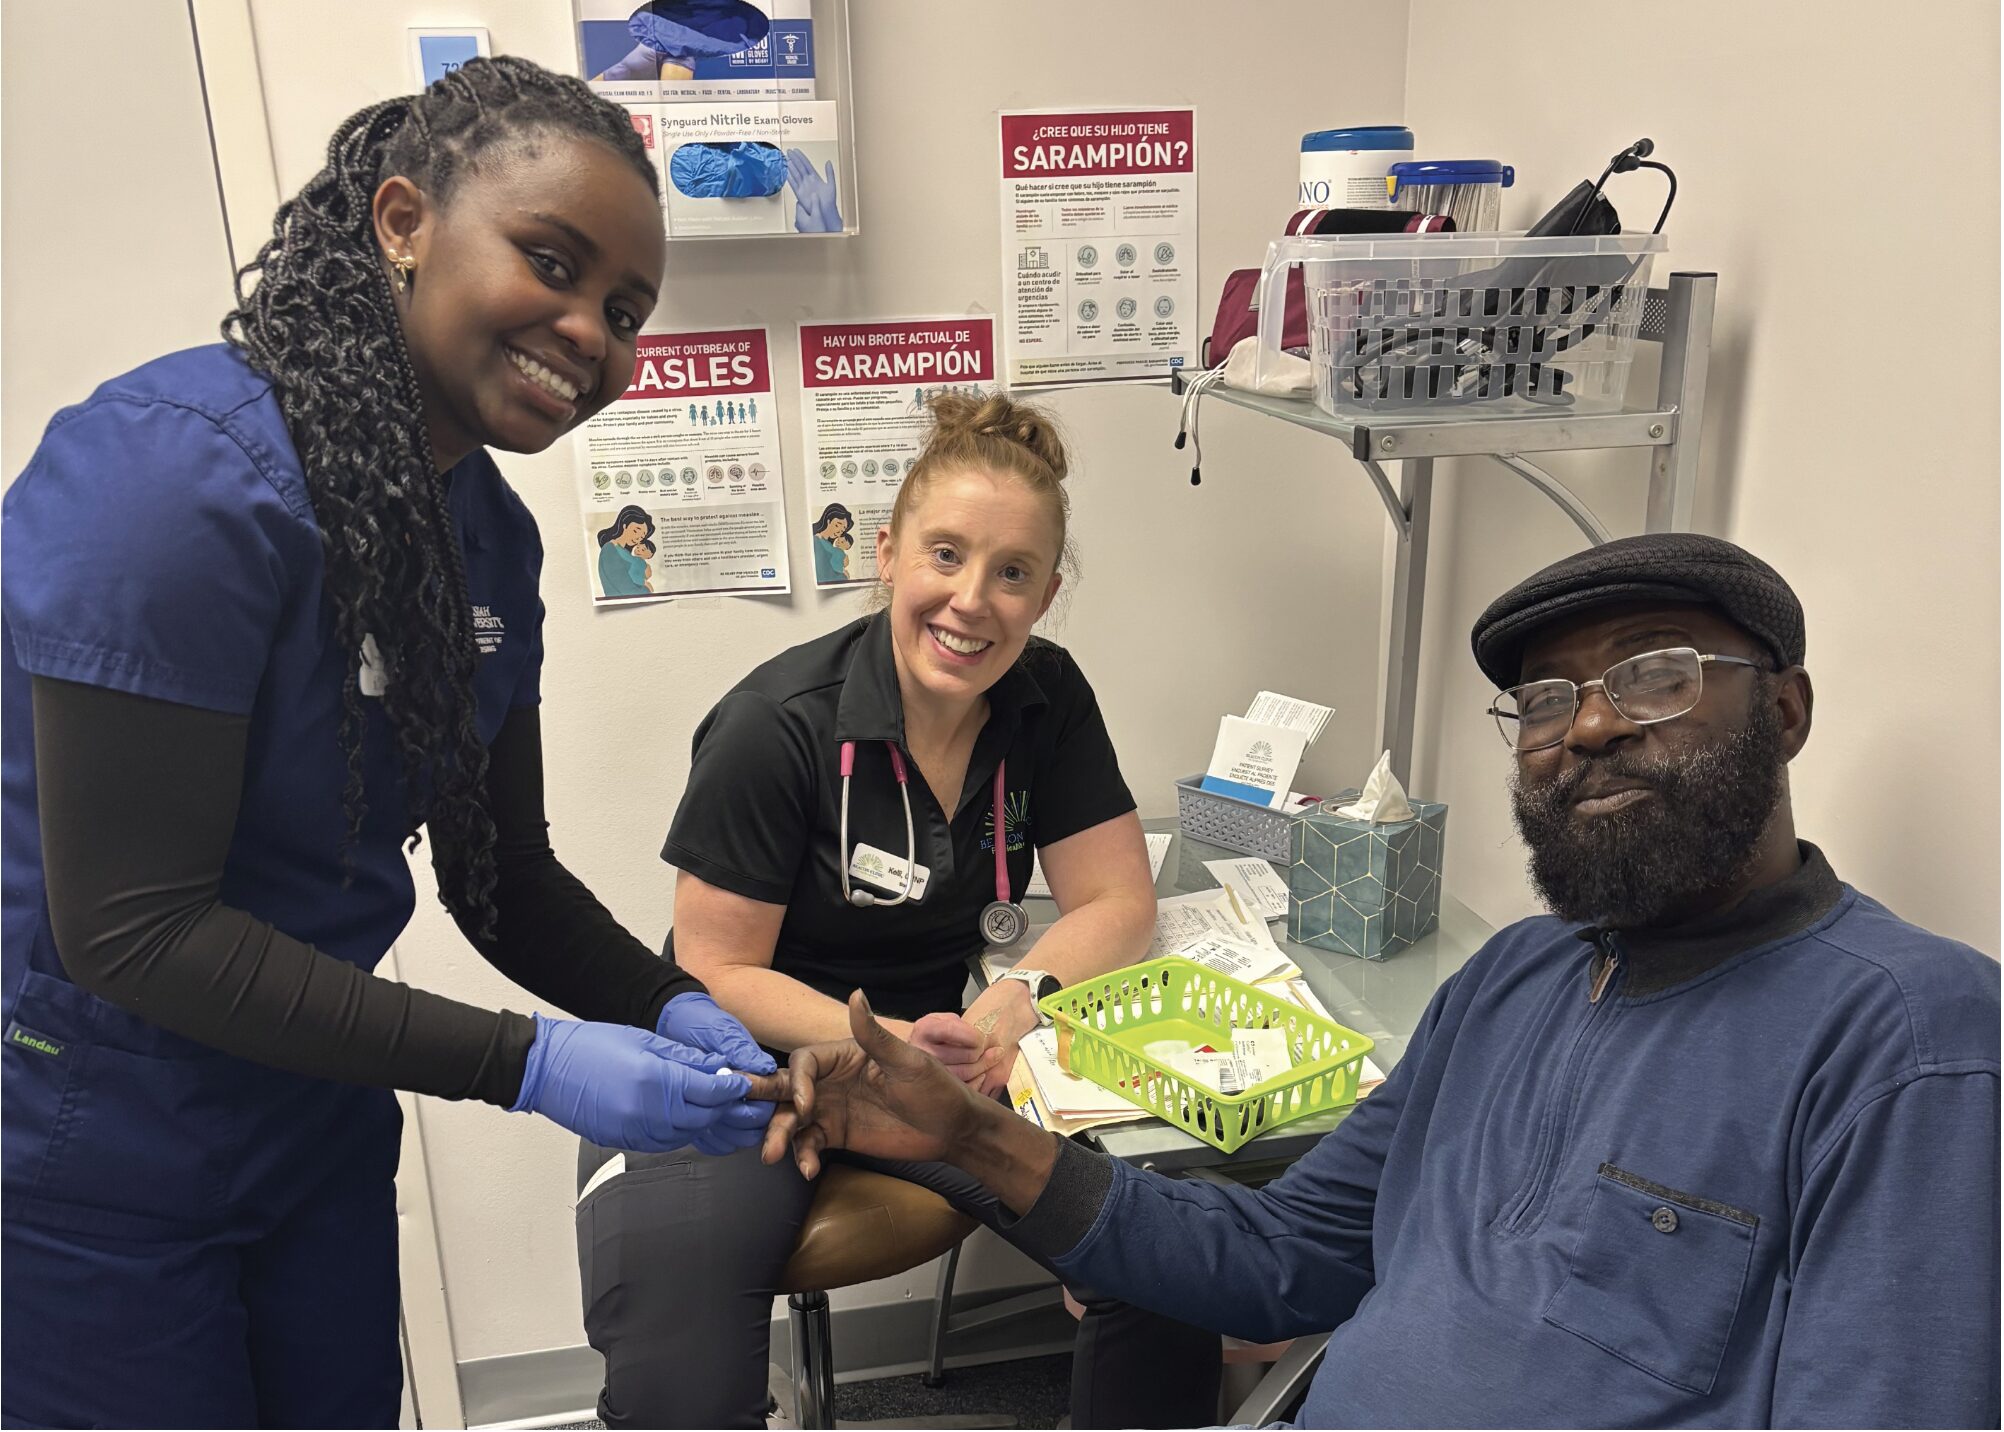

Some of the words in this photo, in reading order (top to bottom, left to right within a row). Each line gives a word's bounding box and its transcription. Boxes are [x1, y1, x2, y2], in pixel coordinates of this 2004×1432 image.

[660, 117, 707, 128] Synguard
[710, 114, 751, 125] Nitrile
[754, 116, 780, 124] Exam
[782, 116, 814, 125] Gloves
[1032, 126, 1068, 140] ¿CREE
[1070, 125, 1092, 137] QUE
[1094, 125, 1108, 136] SU
[1111, 124, 1136, 136] HIJO
[1137, 123, 1169, 135] TIENE
[1013, 136, 1188, 171] SARAMPIÓN?
[1092, 182, 1104, 190] hijo
[1122, 180, 1156, 189] sarampión
[1298, 181, 1330, 203] NO
[1018, 294, 1048, 302] urgencias
[823, 336, 846, 347] HAY
[849, 334, 866, 346] UN
[868, 333, 906, 346] BROTE
[908, 332, 953, 344] ACTUAL
[955, 331, 970, 343] DE
[637, 346, 681, 359] CURRENT
[684, 342, 735, 354] OUTBREAK
[738, 341, 751, 352] OF
[815, 344, 981, 380] SARAMPIÓN
[626, 354, 754, 391] ASLES
[472, 605, 490, 616] SIAH
[1256, 765, 1274, 773] SURVEY
[980, 832, 1024, 850] BEON
[13, 1030, 60, 1056] Landau
